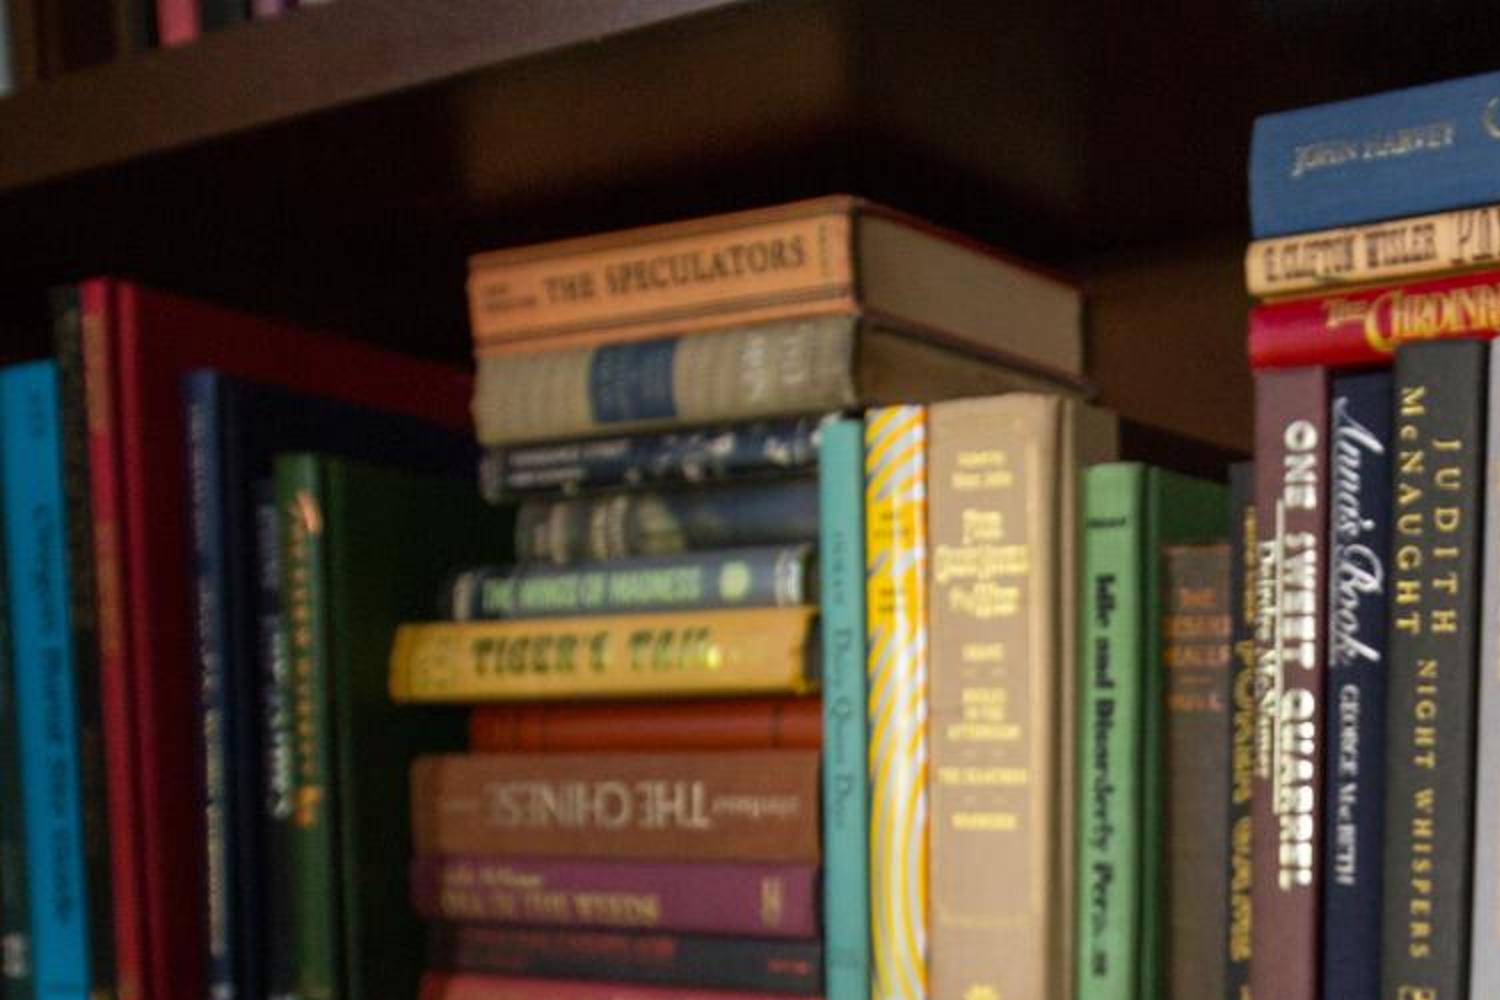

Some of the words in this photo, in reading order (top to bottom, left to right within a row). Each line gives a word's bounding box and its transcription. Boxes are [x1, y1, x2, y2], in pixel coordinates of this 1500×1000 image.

[545, 270, 595, 302] THE
[605, 235, 806, 294] SPECULATORS
[1284, 420, 1318, 510] ONE
[1396, 385, 1427, 635] McNAUGHT
[1432, 439, 1462, 633] JUDITH
[1282, 532, 1316, 670] SWEET
[1413, 659, 1438, 769] NIGHT
[636, 779, 714, 831] THE
[1408, 787, 1436, 958] WHISPERS
